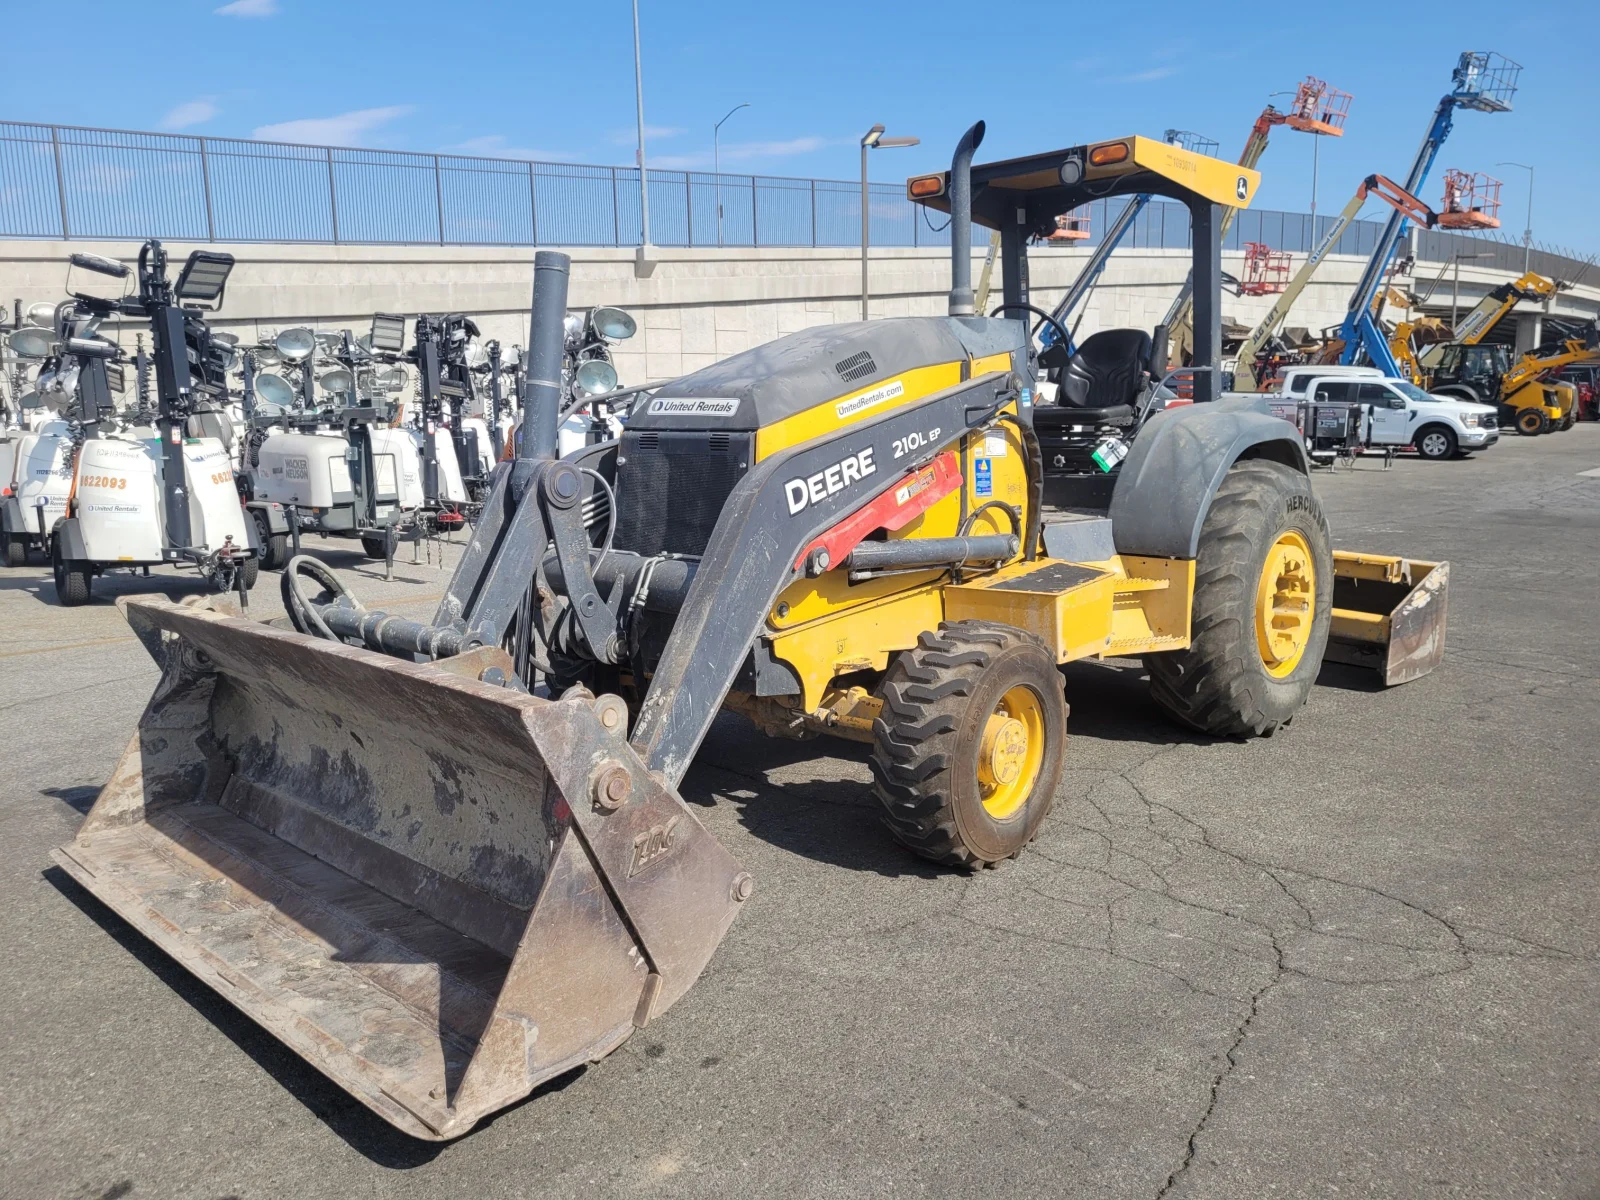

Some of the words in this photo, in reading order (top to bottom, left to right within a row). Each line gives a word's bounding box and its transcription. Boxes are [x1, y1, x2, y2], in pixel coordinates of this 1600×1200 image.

[1252, 328, 1265, 344] JLG
[1264, 306, 1280, 327] LIFT
[664, 402, 694, 412] United
[696, 402, 733, 412] Rentals
[838, 384, 902, 416] UnitedRentals.com
[892, 432, 927, 459] 210L
[929, 428, 941, 441] EP
[285, 459, 307, 469] WACKER
[286, 469, 308, 479] NEUSON
[785, 447, 876, 516] DEERE
